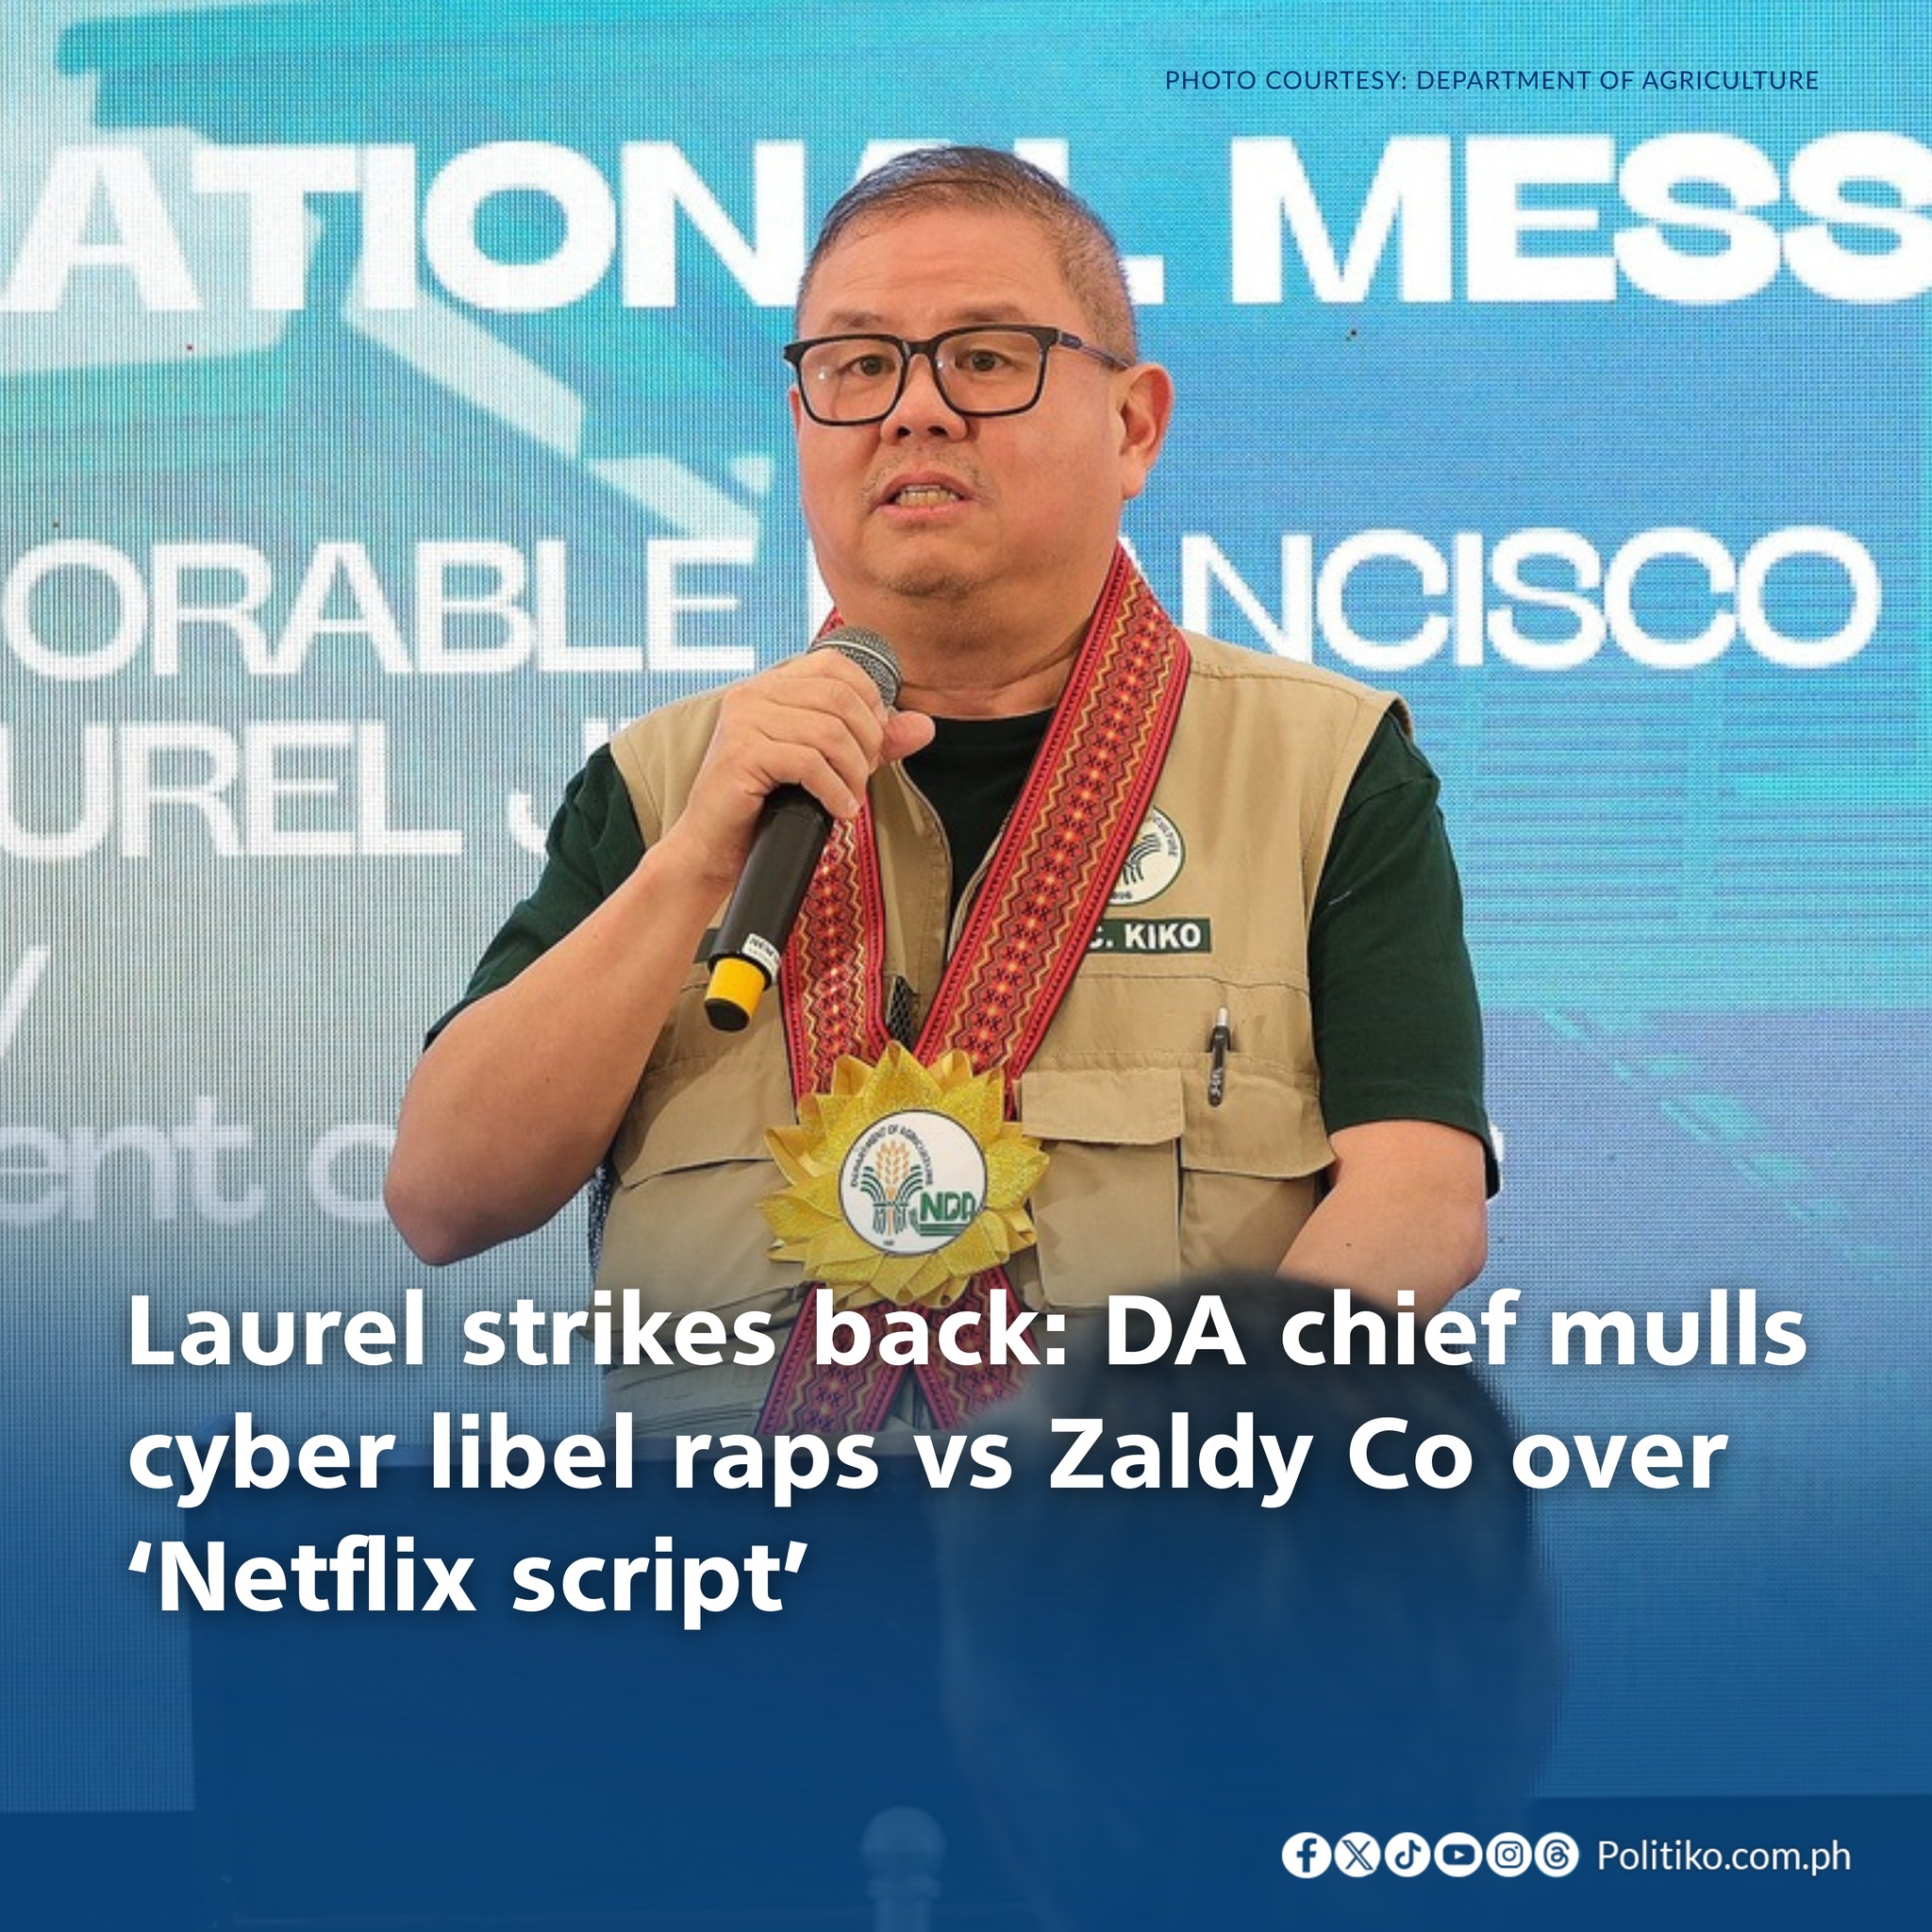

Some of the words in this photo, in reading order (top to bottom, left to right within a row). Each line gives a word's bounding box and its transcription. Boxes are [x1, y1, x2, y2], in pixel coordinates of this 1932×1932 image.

[0, 139, 1165, 313] ATION
[1229, 130, 1932, 307] MESS
[2, 538, 758, 681] ORABLE
[0, 719, 463, 862] UREL
[1124, 922, 1202, 950] KIKO
